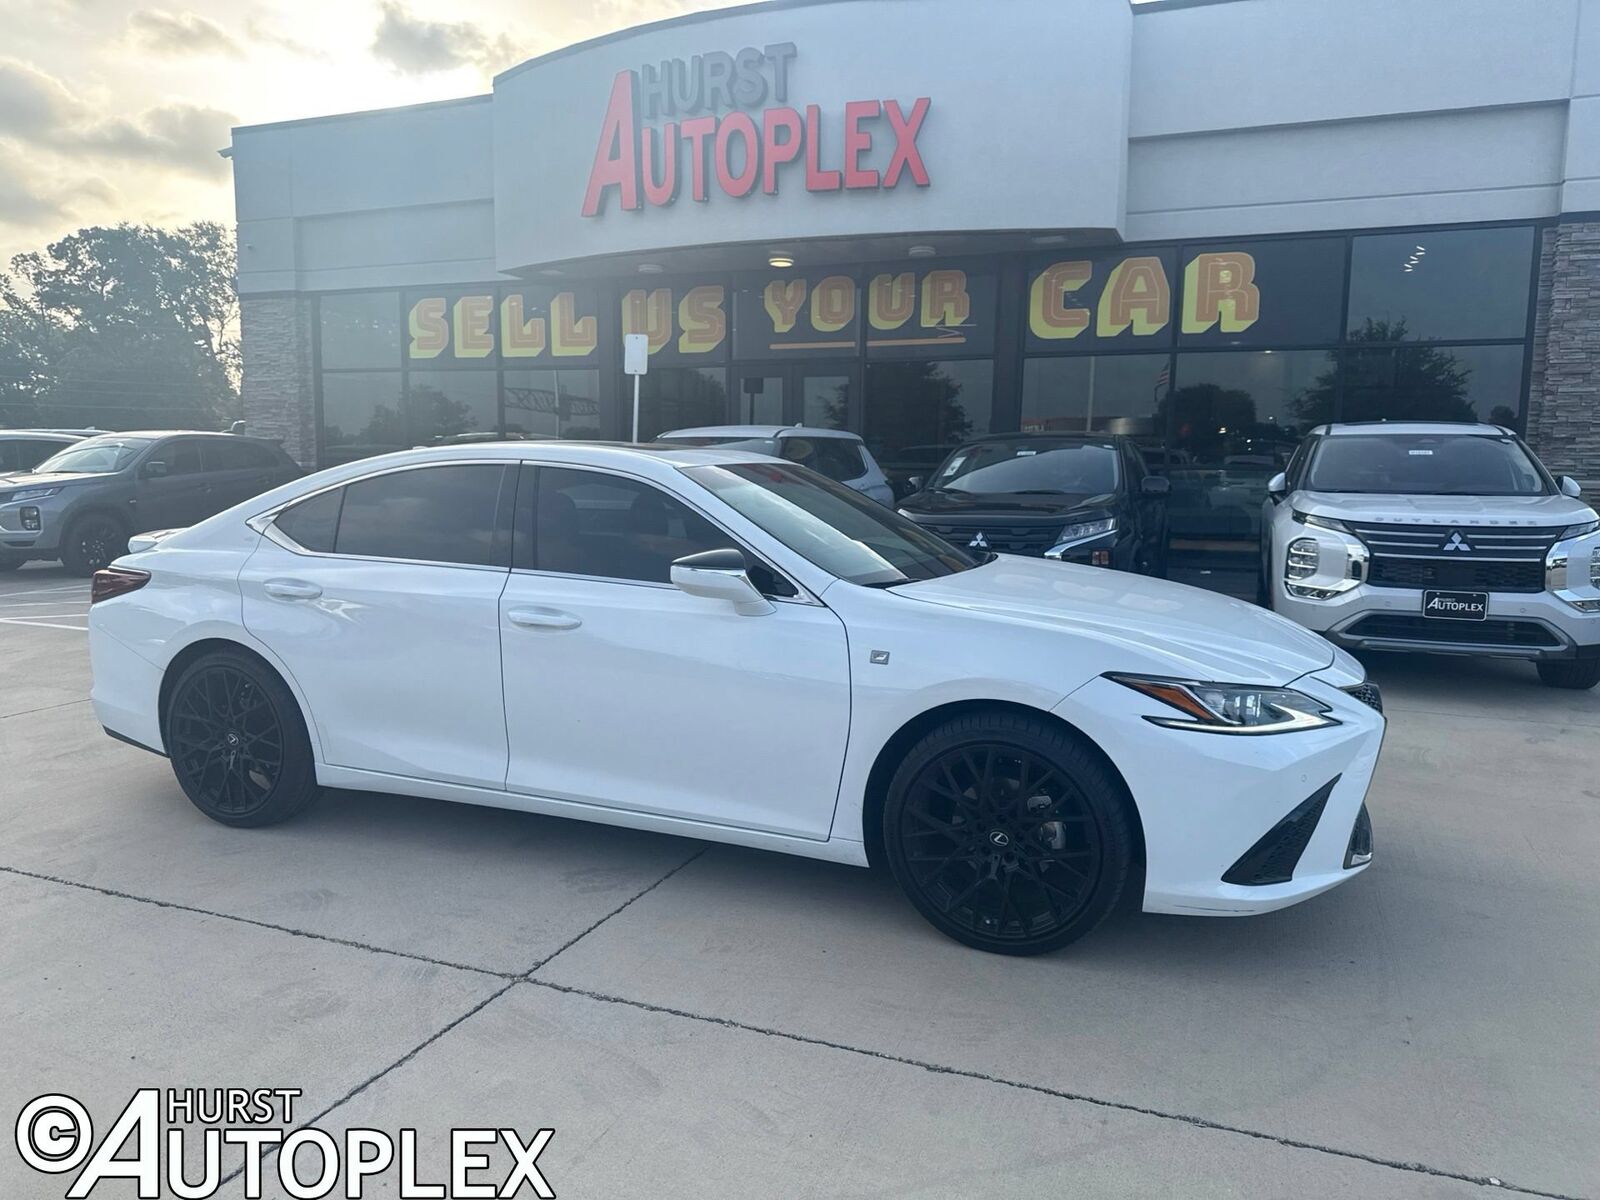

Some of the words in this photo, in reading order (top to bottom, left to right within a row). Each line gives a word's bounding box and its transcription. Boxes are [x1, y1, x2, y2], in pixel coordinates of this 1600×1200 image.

[641, 42, 797, 120] HURST
[581, 69, 931, 217] AUTOPLEX
[409, 292, 597, 358] SELL
[622, 285, 726, 355] US
[764, 270, 970, 332] YOUR
[1030, 252, 1260, 339] CAR
[1427, 597, 1484, 611] AUTOPLEX
